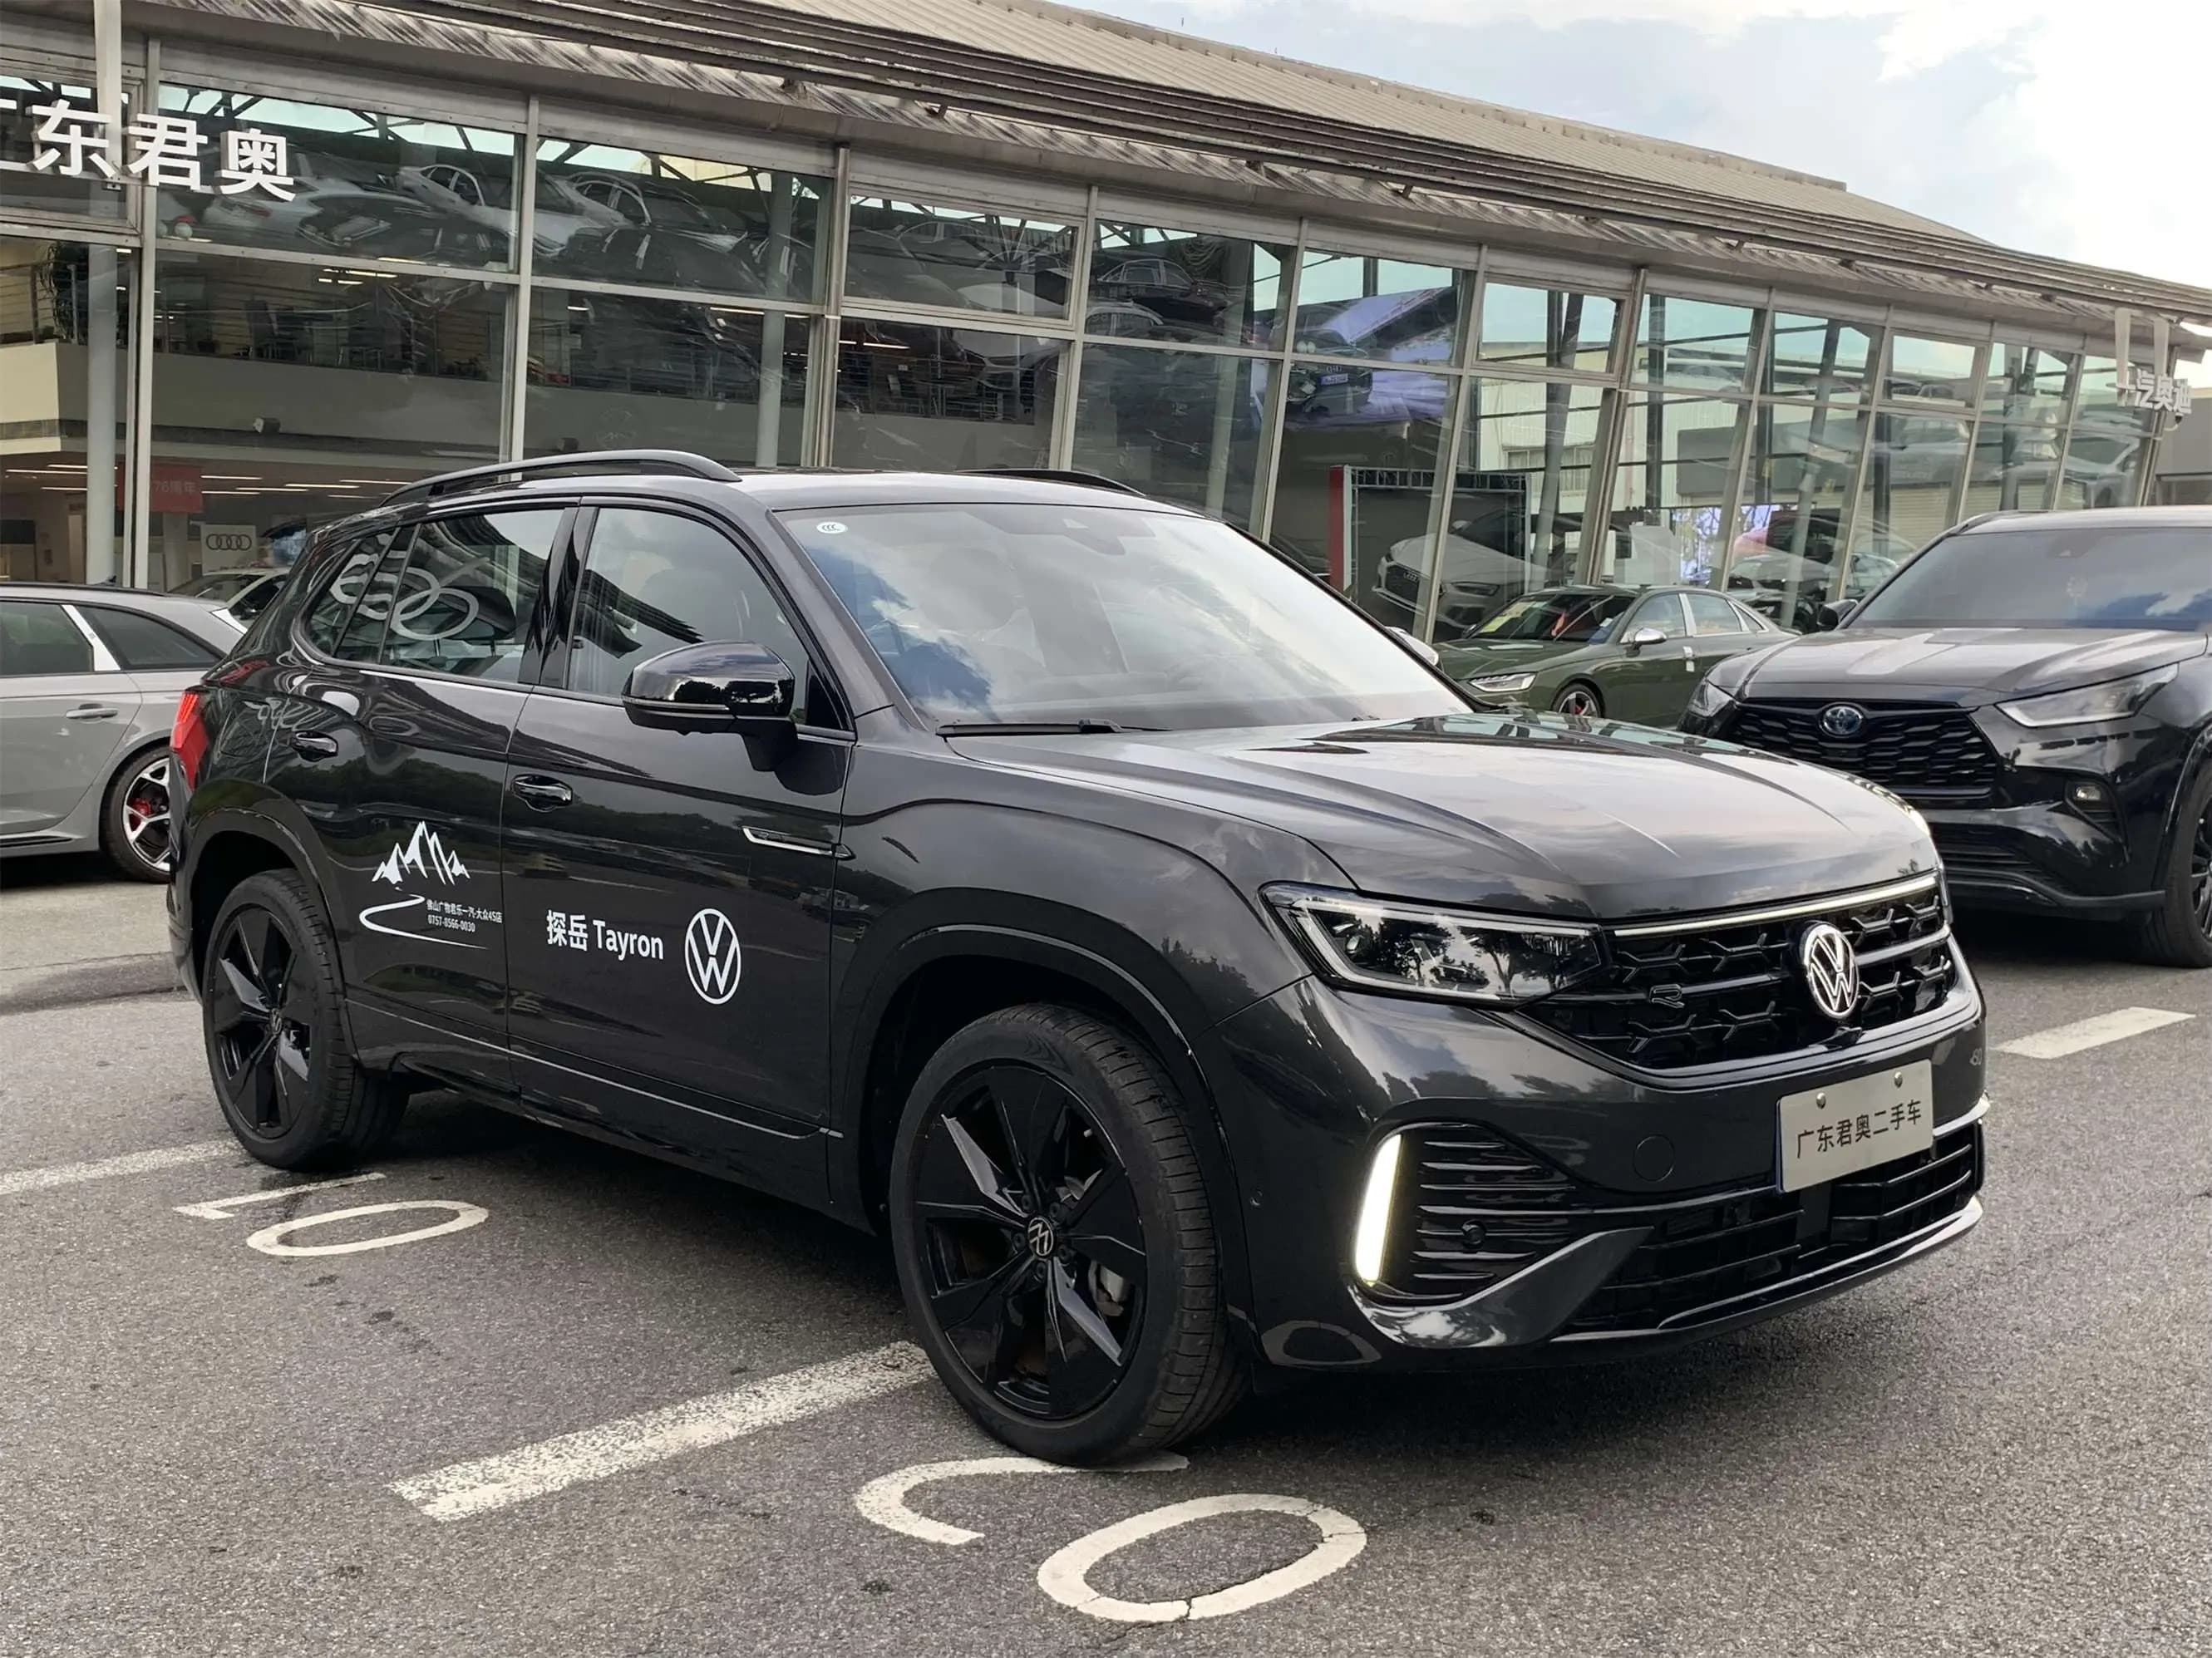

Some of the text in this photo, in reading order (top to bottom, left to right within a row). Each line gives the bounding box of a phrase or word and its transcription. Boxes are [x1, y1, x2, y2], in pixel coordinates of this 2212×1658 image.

[0, 98, 296, 201] 东君奥
[546, 909, 664, 961] 探岳 Tayron
[1797, 1099, 1922, 1159] 广东君奥二手车
